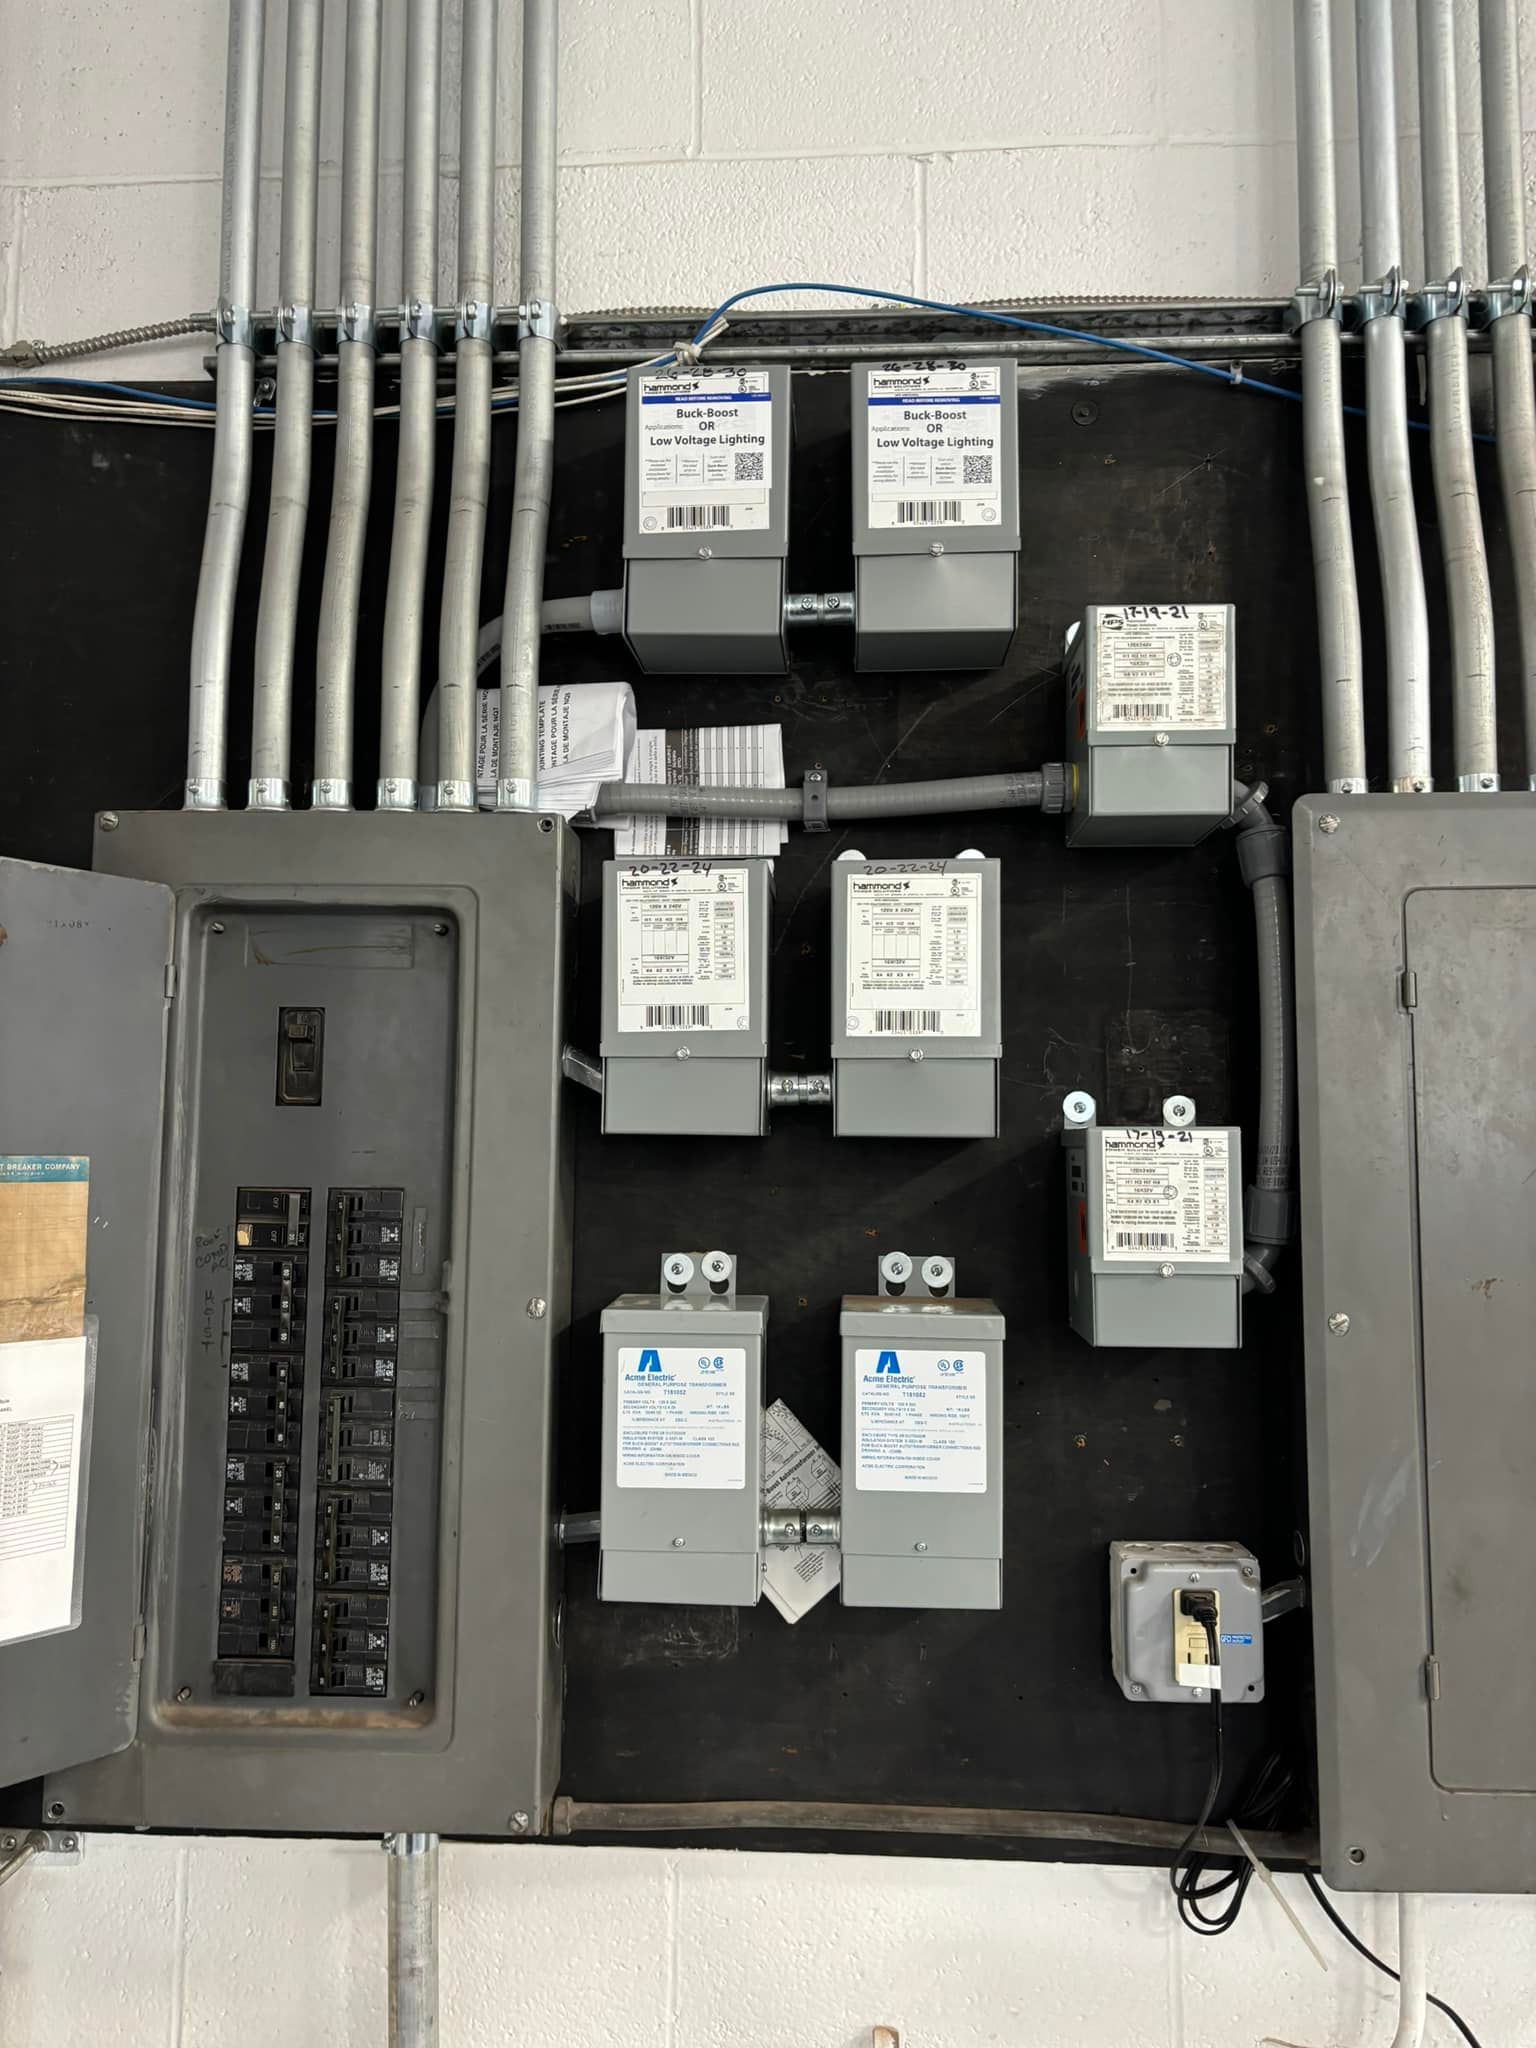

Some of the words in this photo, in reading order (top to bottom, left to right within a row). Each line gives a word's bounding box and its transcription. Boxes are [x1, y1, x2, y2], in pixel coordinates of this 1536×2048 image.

[882, 360, 966, 372] 26-28-30
[655, 368, 746, 380] 26-28-30
[873, 377, 921, 385] hammond
[644, 382, 691, 391] hammond
[677, 408, 738, 418] Buck-Boost
[904, 410, 967, 420] Buck-Boost
[699, 422, 715, 430] OR
[926, 424, 943, 432] OR
[650, 437, 672, 446] Low
[675, 435, 716, 446] Voltage
[720, 434, 765, 445] Lighting
[877, 437, 896, 448] Low
[900, 437, 944, 449] Voltage
[947, 436, 994, 449] Lighting
[1124, 606, 1189, 620] 17-19-21
[551, 706, 557, 716] LA
[481, 725, 488, 733] LA
[479, 735, 487, 754] POUR
[563, 743, 569, 753] DE
[491, 759, 497, 767] DE
[629, 862, 712, 877] 20-22-24
[863, 861, 947, 876] 20-22-24
[622, 878, 669, 886] hammond
[853, 882, 902, 890] hammond
[1126, 1129, 1193, 1146] 17-19-21
[1105, 1140, 1156, 1148] hammond
[863, 1375, 884, 1383] Acme
